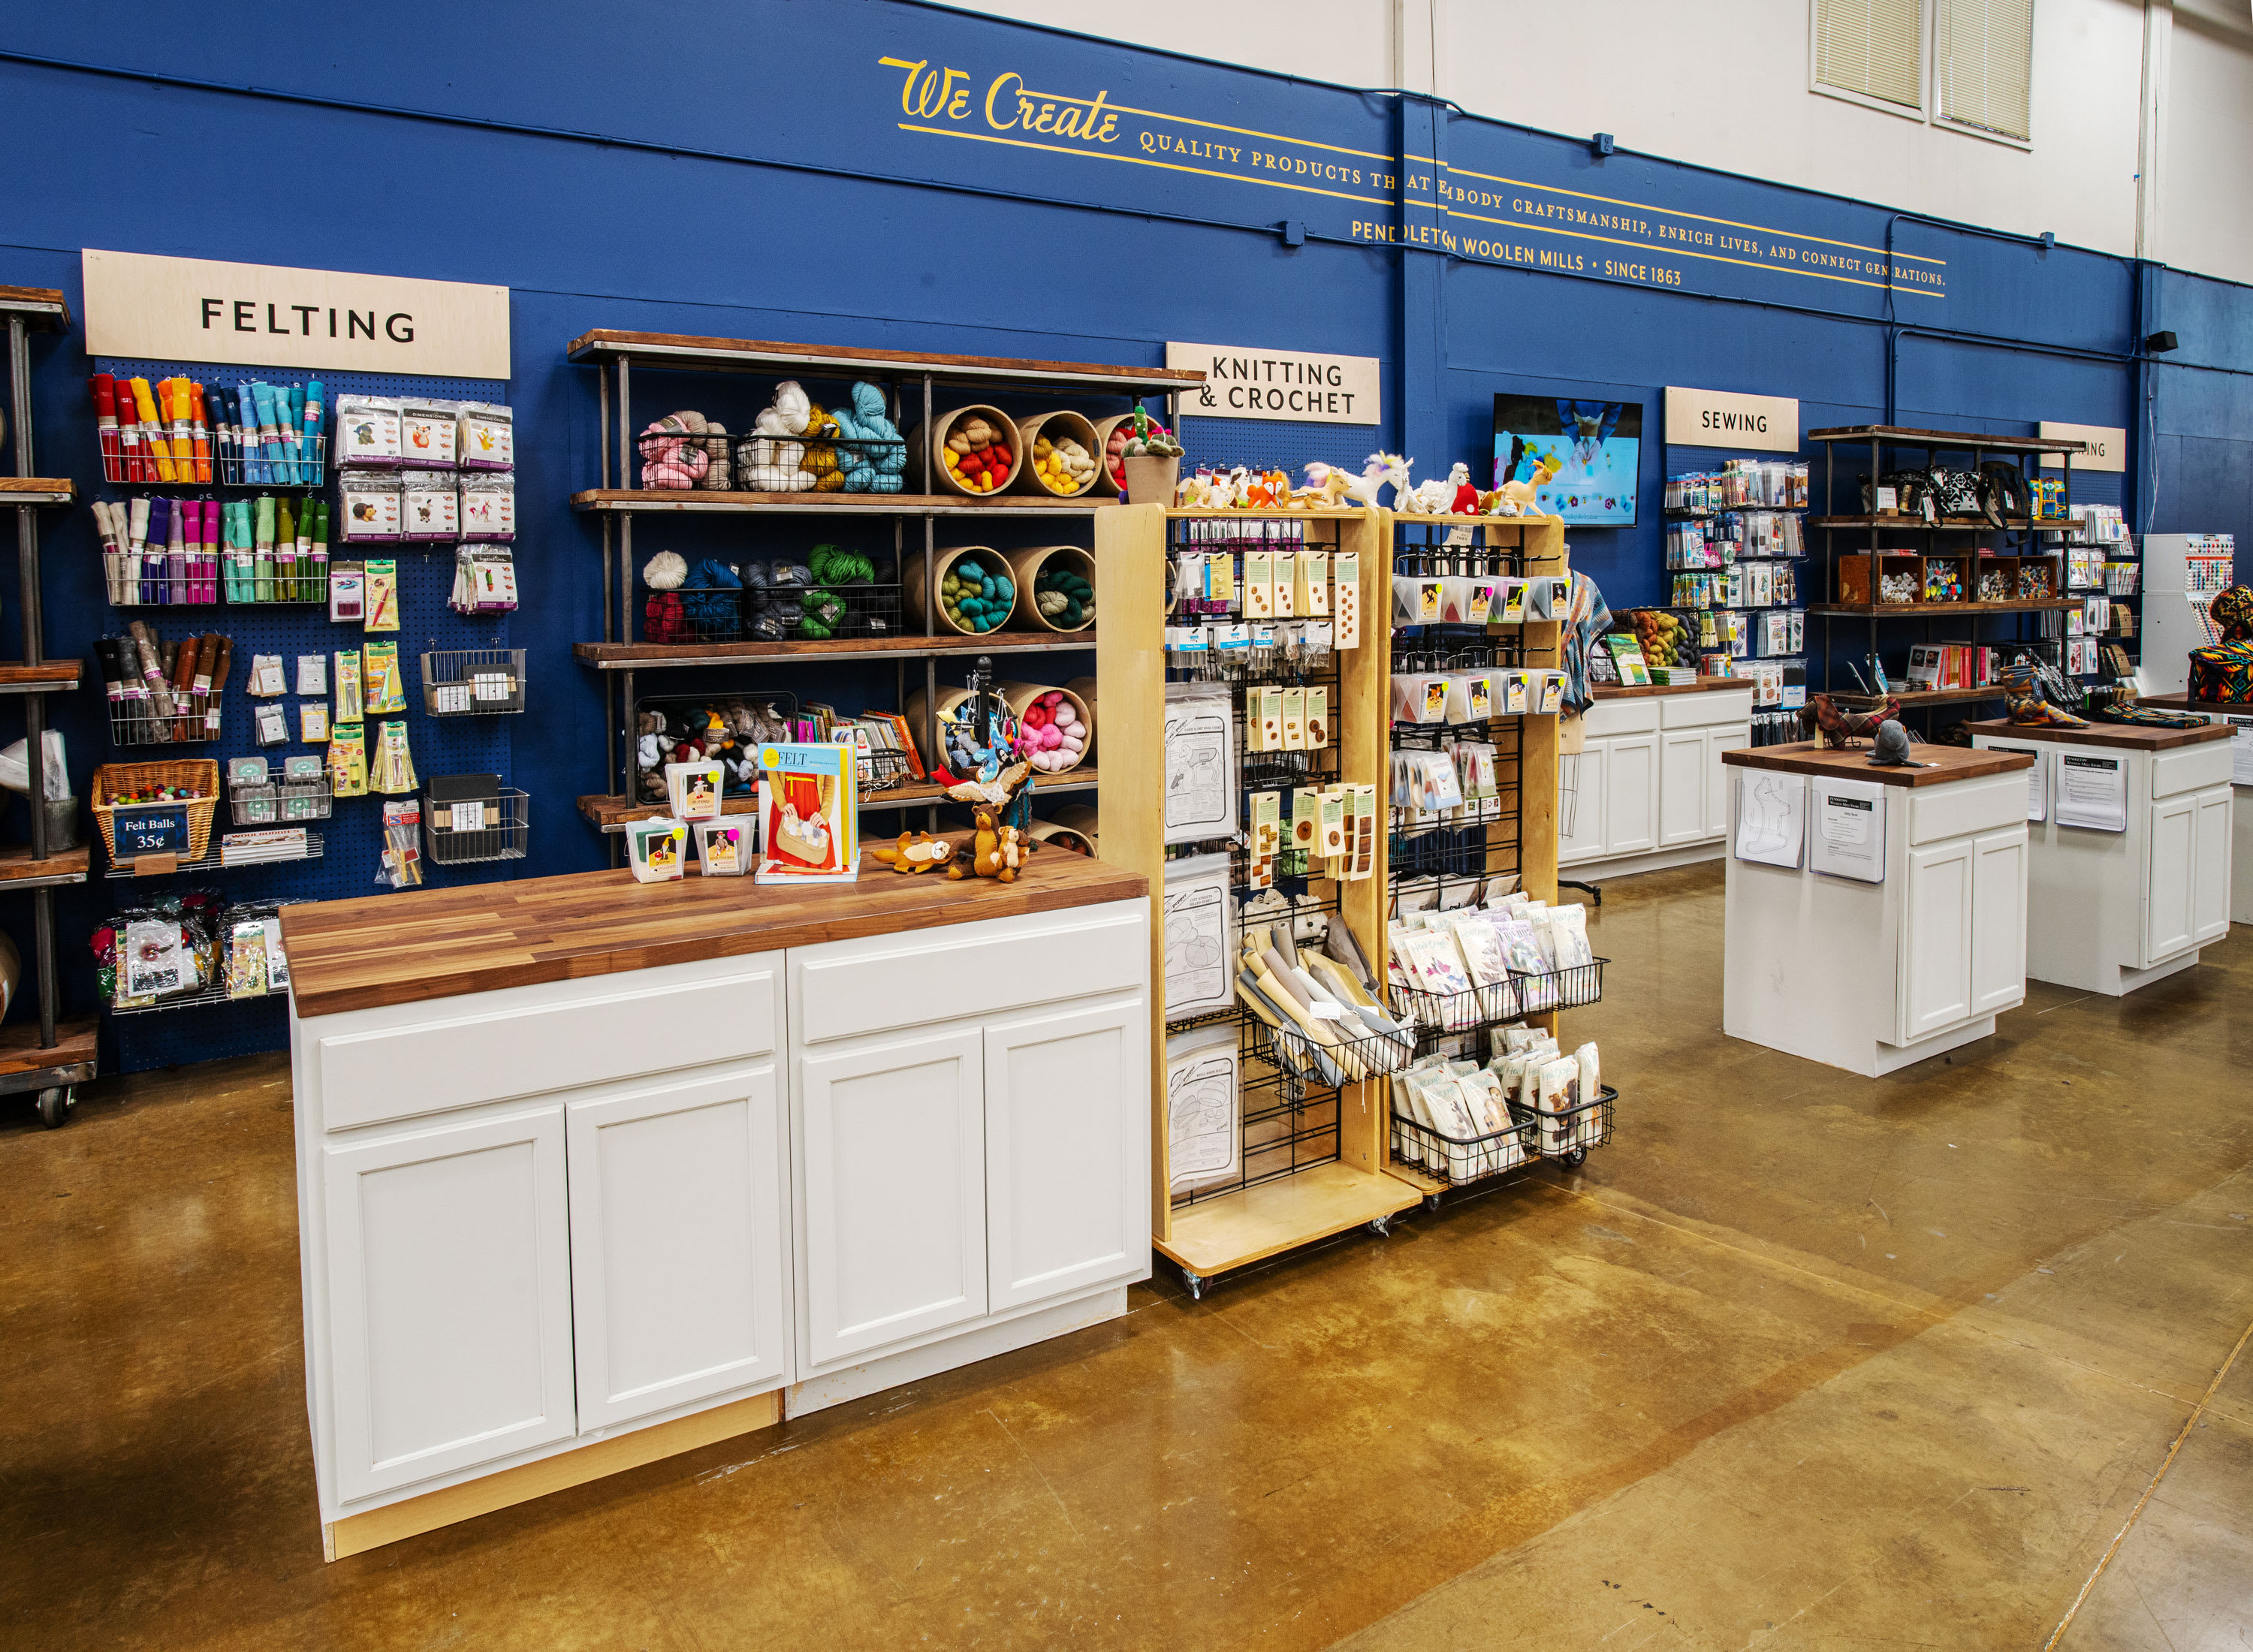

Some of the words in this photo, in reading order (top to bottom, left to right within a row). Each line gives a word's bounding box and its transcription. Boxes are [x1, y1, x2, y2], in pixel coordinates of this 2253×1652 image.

[985, 72, 1120, 144] Create
[1139, 130, 1241, 164] QUALITY
[1251, 151, 1362, 185] PRODUCTS
[1370, 172, 1430, 191] THAT
[1513, 198, 1652, 238] CRAFTSMANSHIP,
[1659, 225, 1714, 249] ENRICH
[1720, 234, 1764, 258] LIVES,
[1769, 242, 1796, 261] AND
[1802, 249, 1860, 271] CONNECT
[1865, 262, 1946, 286] GENRATIONS.
[1463, 237, 1534, 264] WOOLEN
[1540, 249, 1583, 270] MILLS
[1605, 259, 1647, 281] SINCE
[1650, 264, 1681, 286] 1863
[201, 297, 415, 344] FELTING
[1212, 356, 1342, 386] KNITTING
[1199, 385, 1217, 408] &
[1229, 386, 1356, 415] CROCHET
[1702, 410, 1767, 433] SEWING
[778, 752, 807, 765] FELT
[125, 821, 146, 831] Felt
[149, 819, 175, 829] Balls
[137, 835, 164, 849] 35¢
[1172, 893, 1187, 909] pepper
